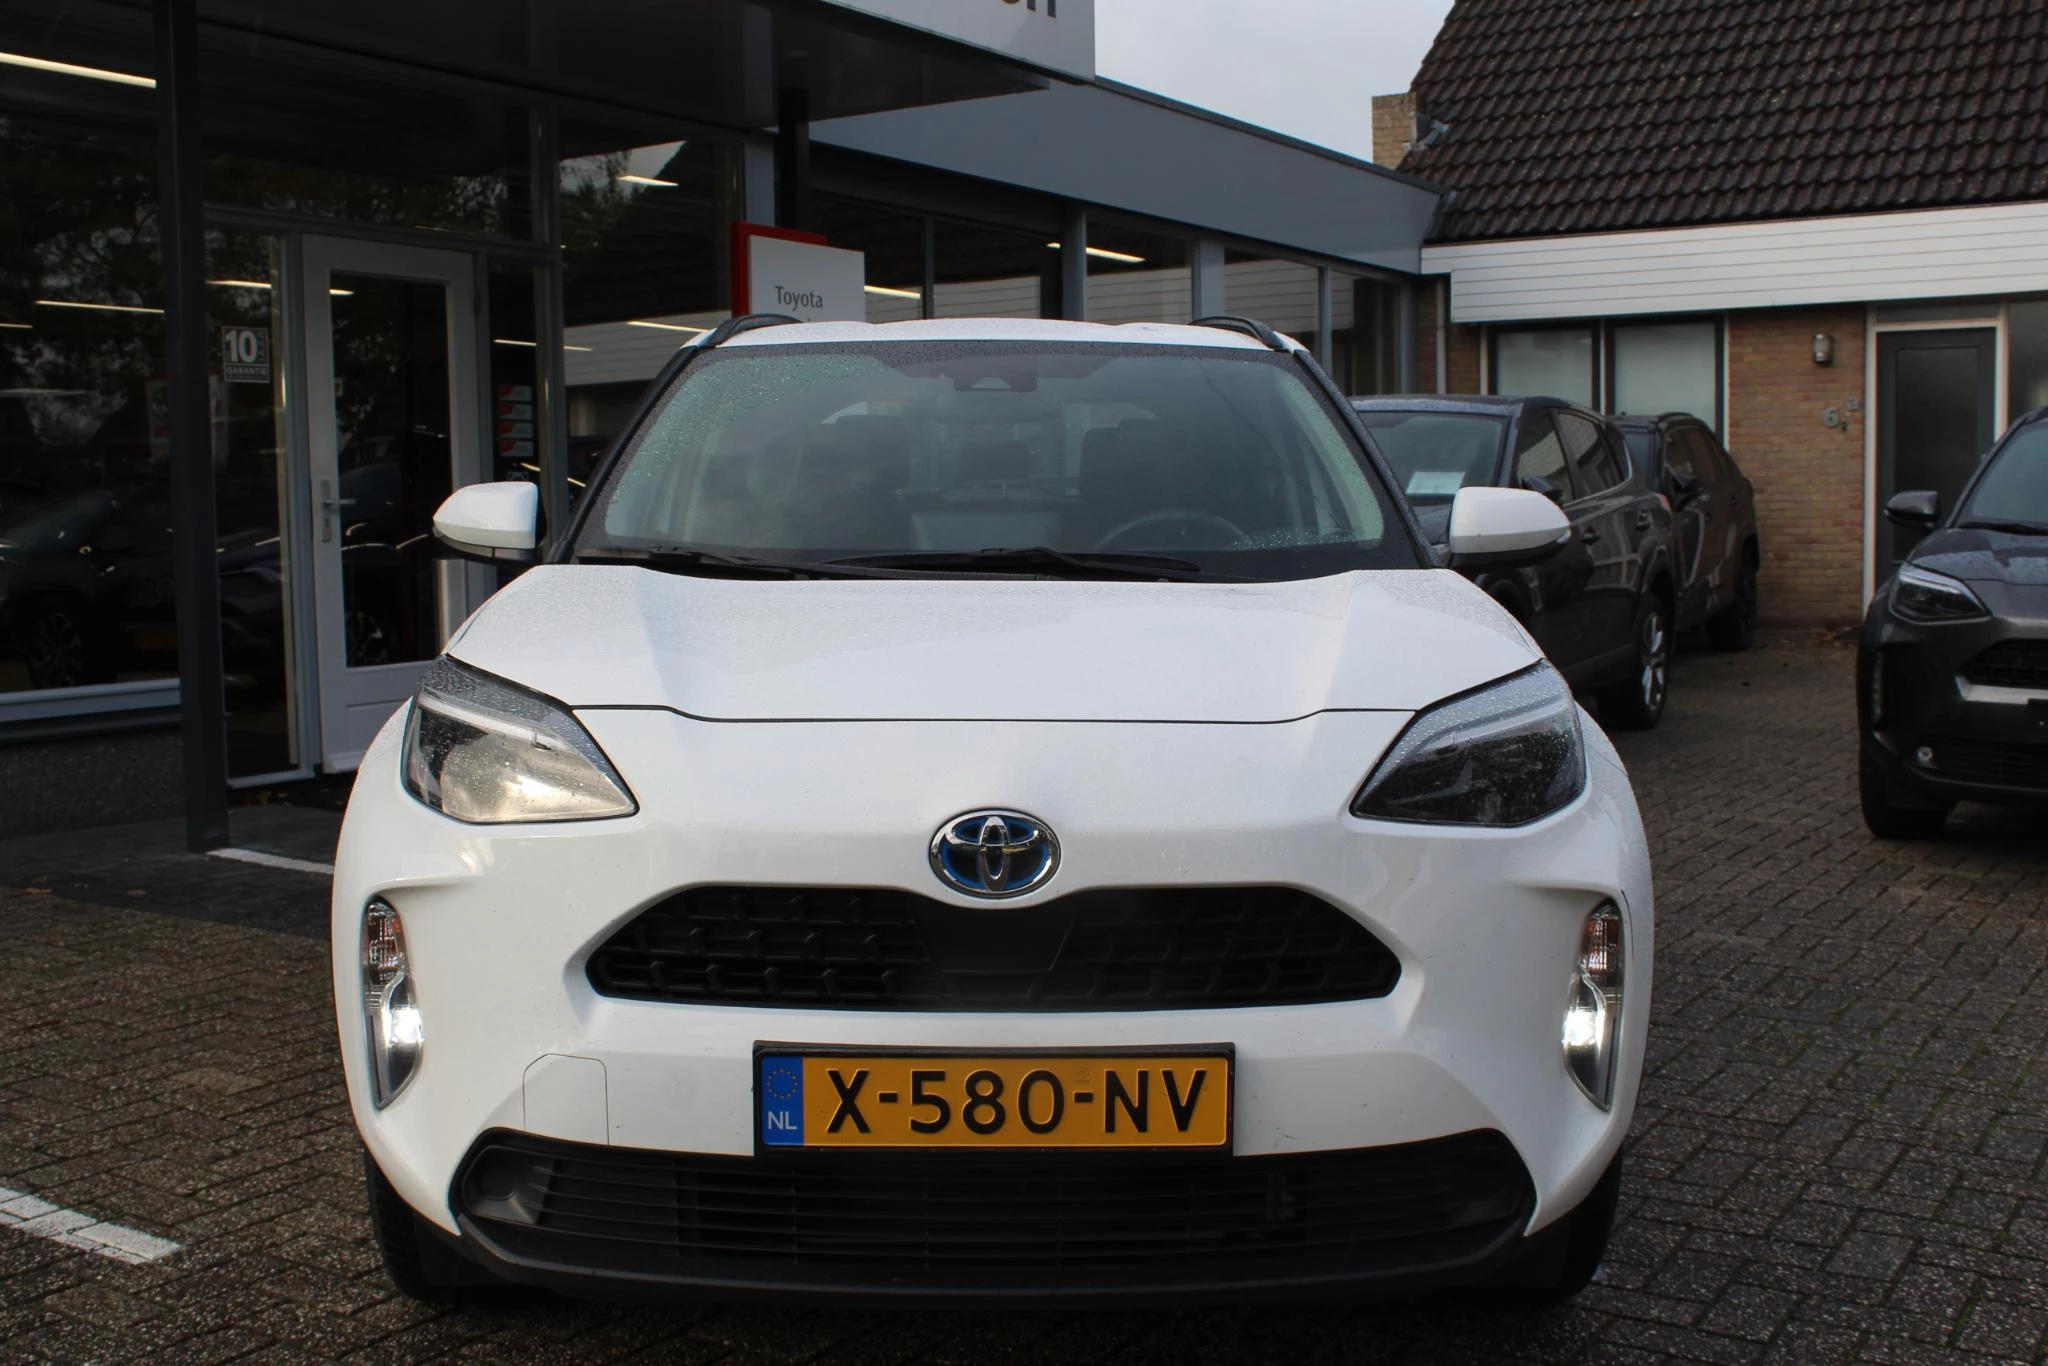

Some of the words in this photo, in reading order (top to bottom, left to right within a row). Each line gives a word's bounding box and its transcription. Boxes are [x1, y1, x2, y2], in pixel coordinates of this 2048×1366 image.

[775, 285, 824, 312] Toyota
[225, 330, 257, 362] 10
[826, 1069, 1206, 1134] X-580-NV
[768, 1111, 797, 1130] NL
